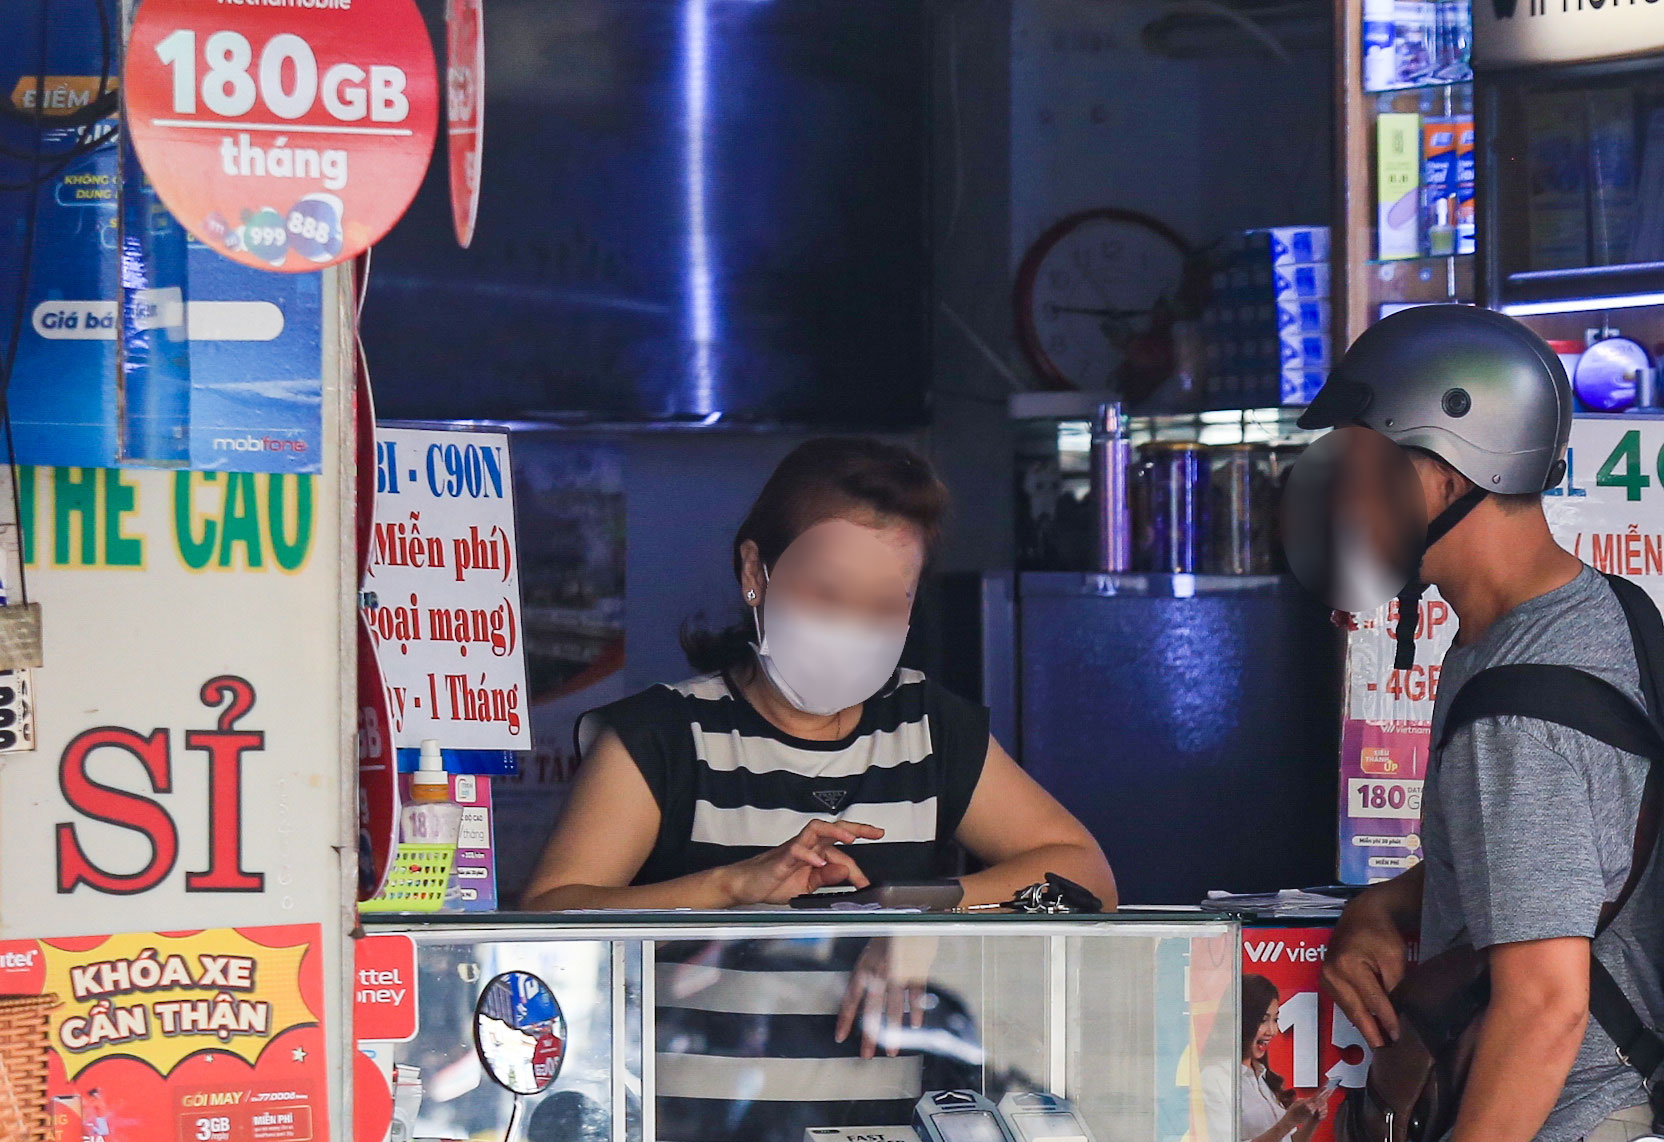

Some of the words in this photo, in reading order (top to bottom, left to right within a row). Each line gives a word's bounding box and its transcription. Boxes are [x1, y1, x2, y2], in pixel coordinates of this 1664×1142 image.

[221, 135, 348, 189] tháng
[249, 226, 287, 246] 999
[288, 212, 329, 243] 888
[213, 436, 307, 453] mobifone
[426, 445, 504, 499] C90N
[454, 525, 512, 583] phí)
[1593, 523, 1664, 577] MIỄN
[428, 597, 517, 657] mạng)
[444, 673, 520, 736] Tháng
[56, 675, 266, 895] SỈ
[1357, 784, 1406, 810] 180
[71, 948, 190, 999] KHÓA
[199, 956, 255, 988] XE
[59, 993, 147, 1050] CẨN
[154, 994, 270, 1042] THẬN
[210, 1092, 243, 1106] MAY
[195, 1117, 230, 1141] 3GB
[847, 1134, 886, 1142] FAST
